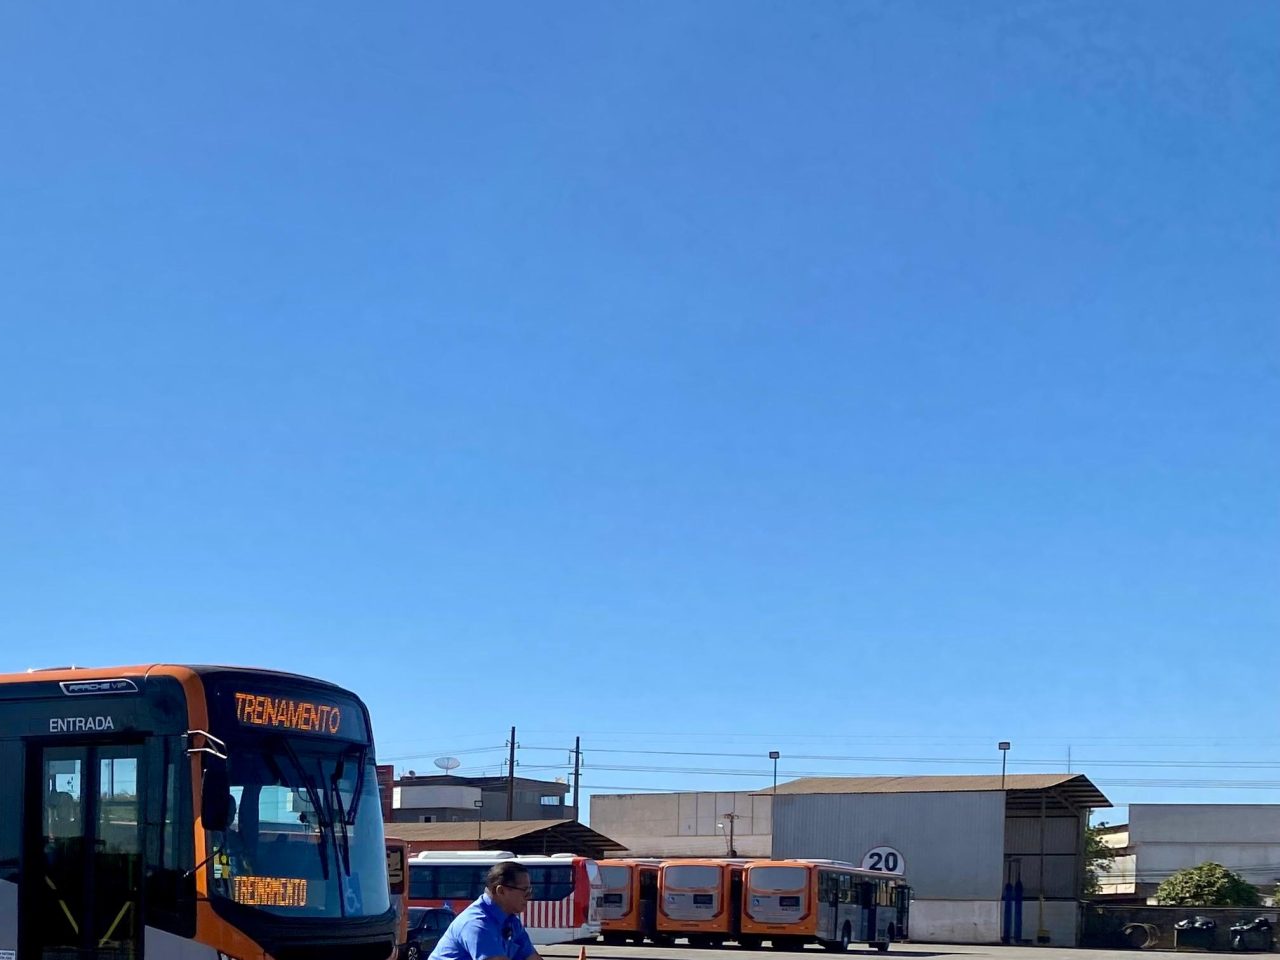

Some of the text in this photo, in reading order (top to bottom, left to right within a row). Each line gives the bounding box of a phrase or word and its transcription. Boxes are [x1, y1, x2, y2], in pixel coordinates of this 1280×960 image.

[235, 692, 340, 734] TREINAMENTO
[49, 716, 114, 732] ENTRADA
[869, 852, 898, 871] 20
